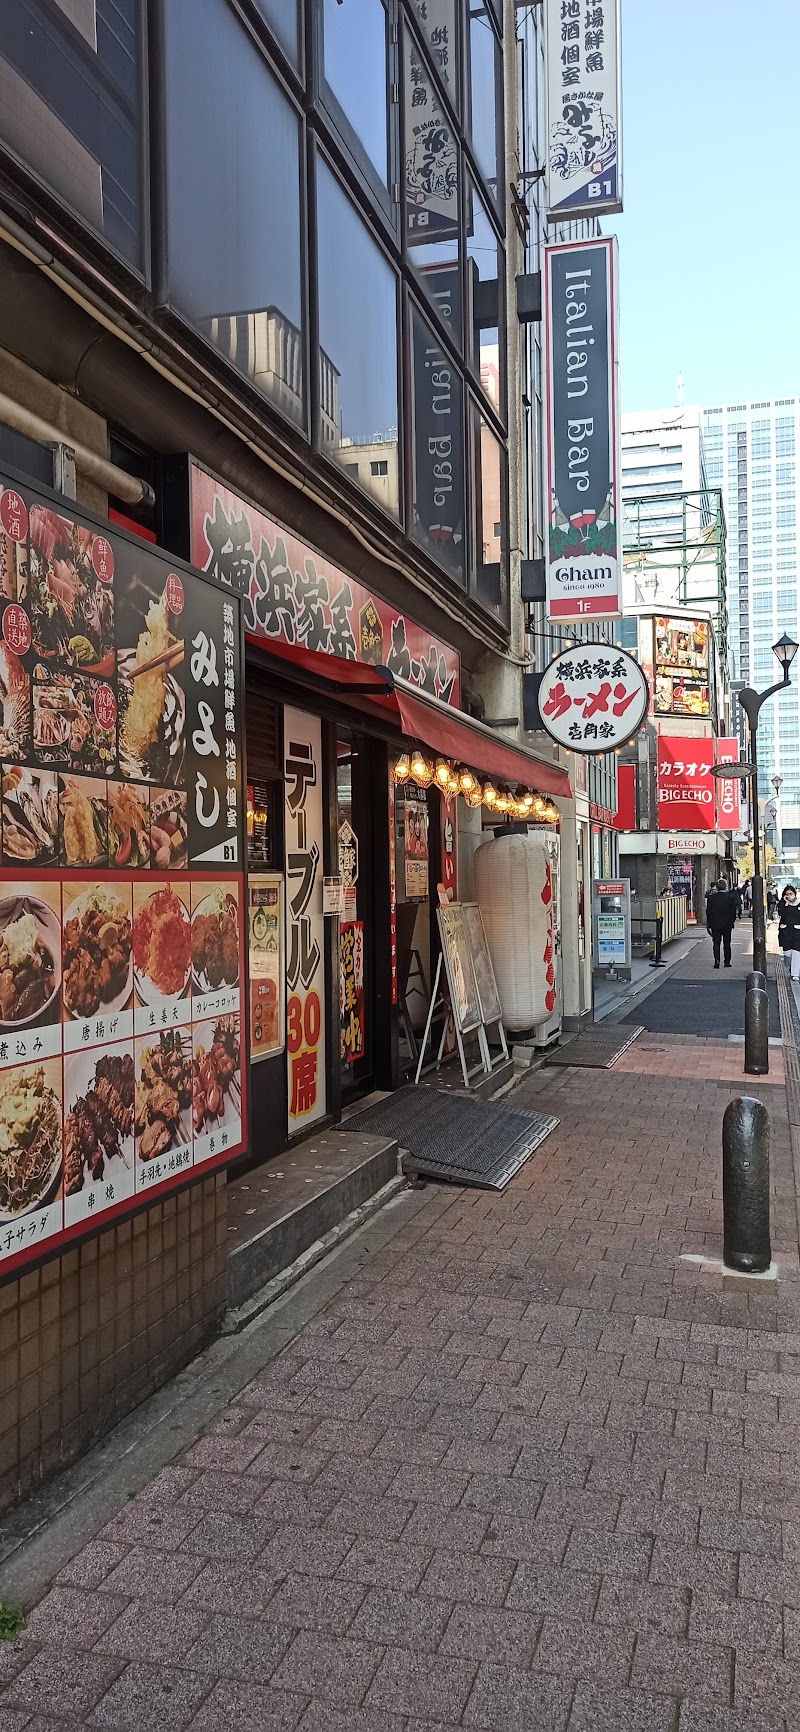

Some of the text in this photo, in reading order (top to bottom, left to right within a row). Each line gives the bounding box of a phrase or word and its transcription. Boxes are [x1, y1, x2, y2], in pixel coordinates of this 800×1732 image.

[588, 180, 612, 198] B1
[565, 268, 595, 492] Italian Bar
[7, 493, 21, 538] 地酒
[98, 540, 109, 579] 鮮魚
[587, 583, 605, 591] 1980
[577, 600, 592, 613] 1F
[7, 609, 18, 647] 直送
[18, 611, 29, 648] 築地
[555, 657, 627, 681] 横浜家系
[543, 682, 642, 721] ラーメン
[191, 630, 220, 828] みよし
[568, 722, 616, 740] 壱角家
[659, 761, 712, 777] カラオケ
[659, 788, 713, 803] BIG ECHO
[223, 845, 235, 861] B1
[668, 840, 706, 849] BIG ECHO
[196, 994, 237, 1013] カレーコロッケ
[149, 1007, 179, 1027] 生姜天
[81, 1018, 119, 1042] 唐揚げ
[87, 1183, 115, 1210] 串焼
[0, 1212, 50, 1252] 子サラダ
